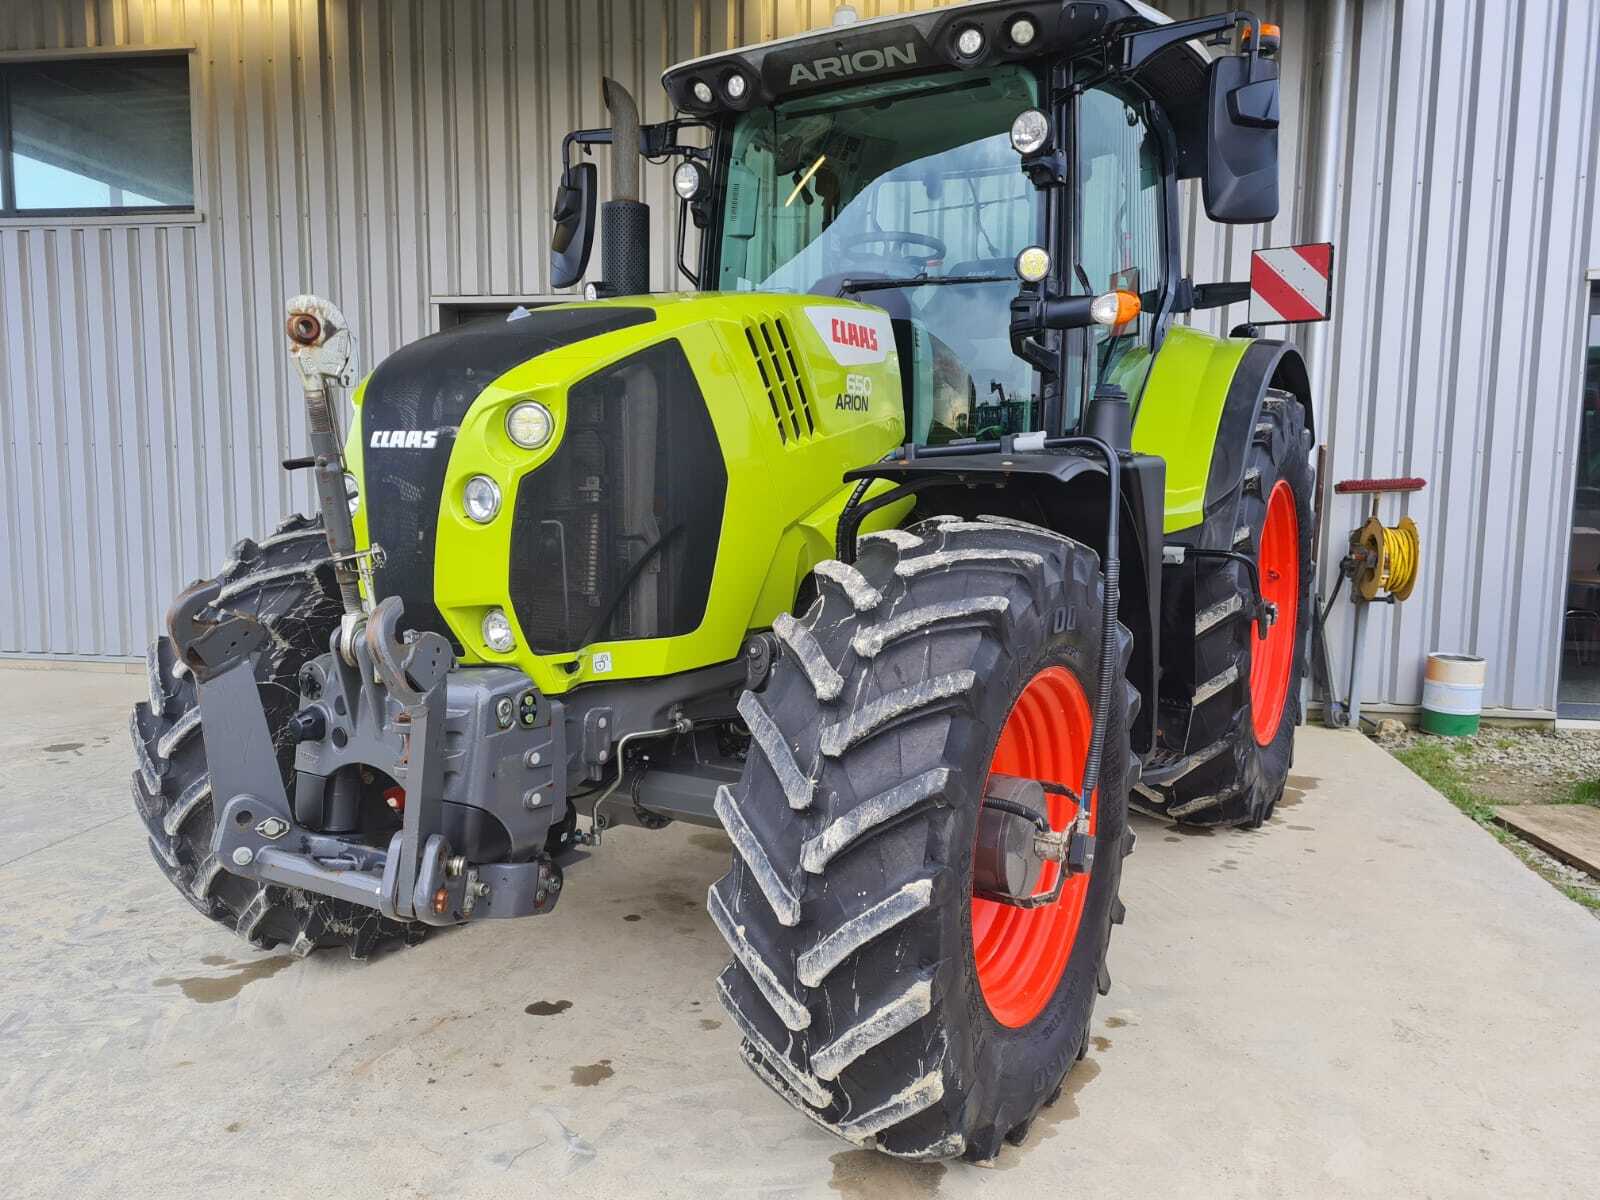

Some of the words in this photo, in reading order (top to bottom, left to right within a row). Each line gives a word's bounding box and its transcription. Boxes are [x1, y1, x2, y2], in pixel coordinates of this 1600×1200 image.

[789, 42, 917, 86] ARION
[831, 318, 878, 352] CLAAS
[846, 373, 872, 395] 650
[835, 393, 869, 412] ARION
[370, 430, 439, 449] CLAAS
